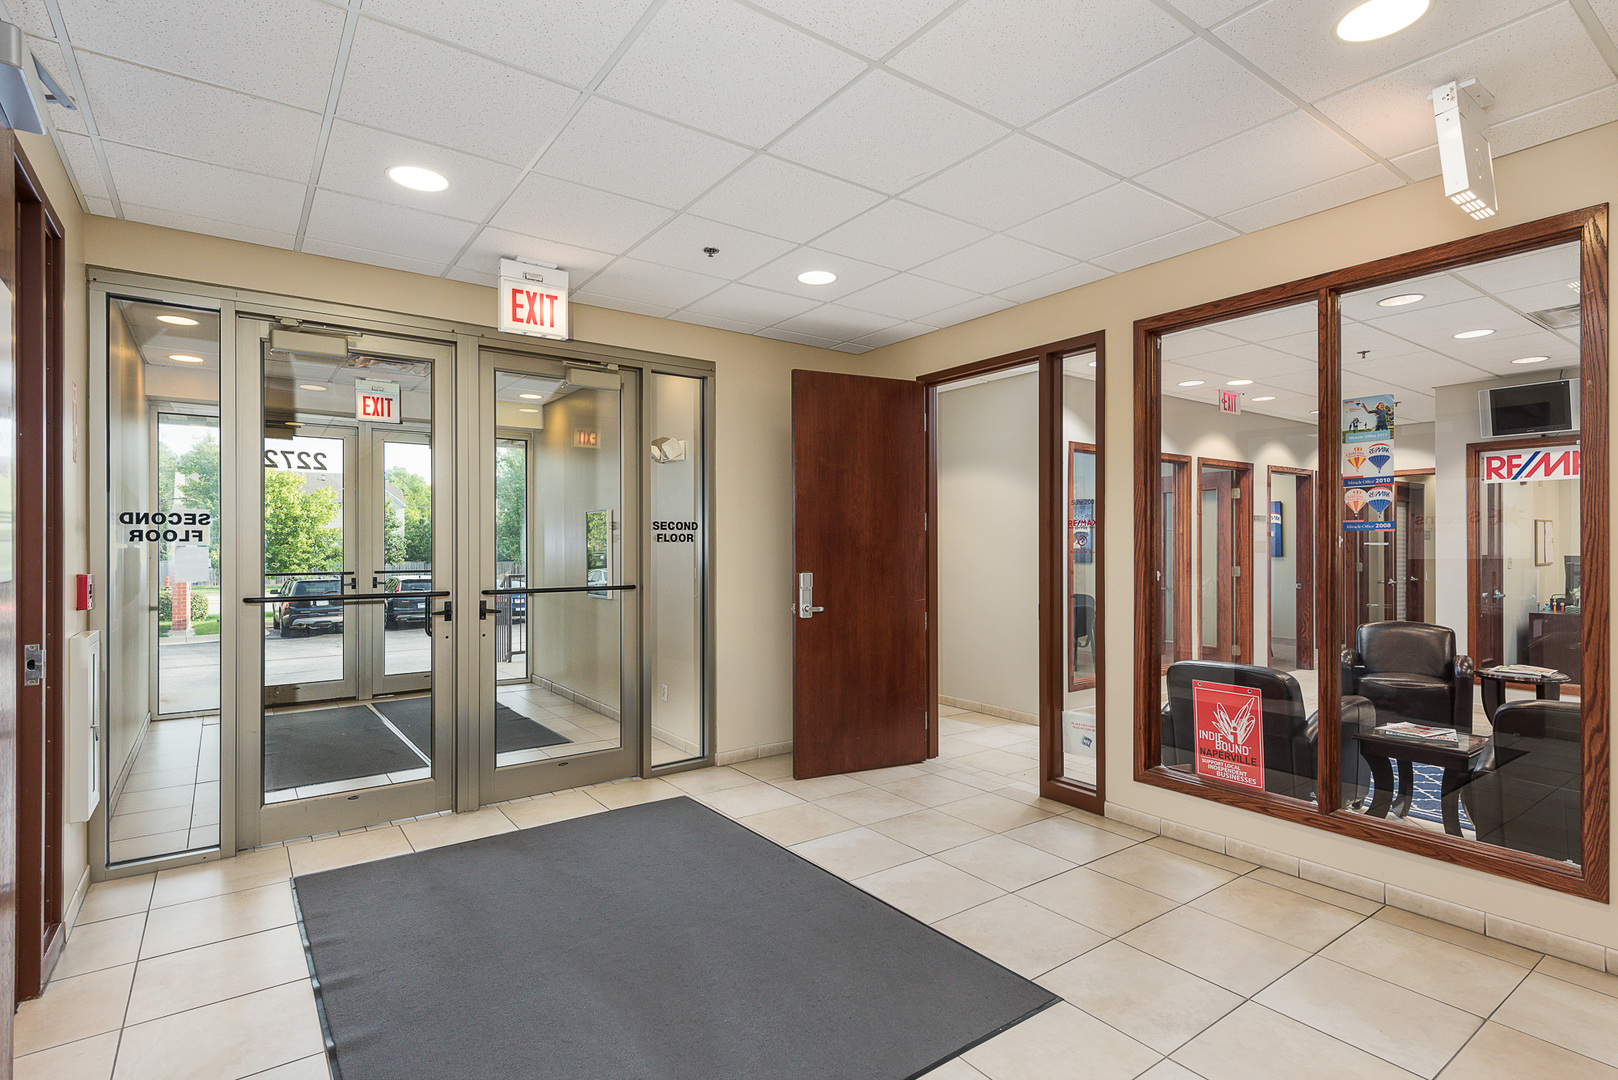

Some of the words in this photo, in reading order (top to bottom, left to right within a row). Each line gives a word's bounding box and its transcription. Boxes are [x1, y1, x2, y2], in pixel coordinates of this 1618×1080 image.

[511, 288, 558, 328] EXIT
[362, 395, 393, 418] EXIT
[1223, 391, 1237, 413] EXIT
[652, 520, 699, 531] SECOND
[656, 533, 694, 543] FLOOR
[1199, 729, 1223, 742] INDIE
[1199, 747, 1258, 767] NAPERVILLE
[1201, 758, 1224, 767] SUPPORT
[1224, 763, 1241, 771] LOCAL
[1207, 763, 1248, 777] INDEPENDENT
[1216, 770, 1257, 785] BUSINESSES
